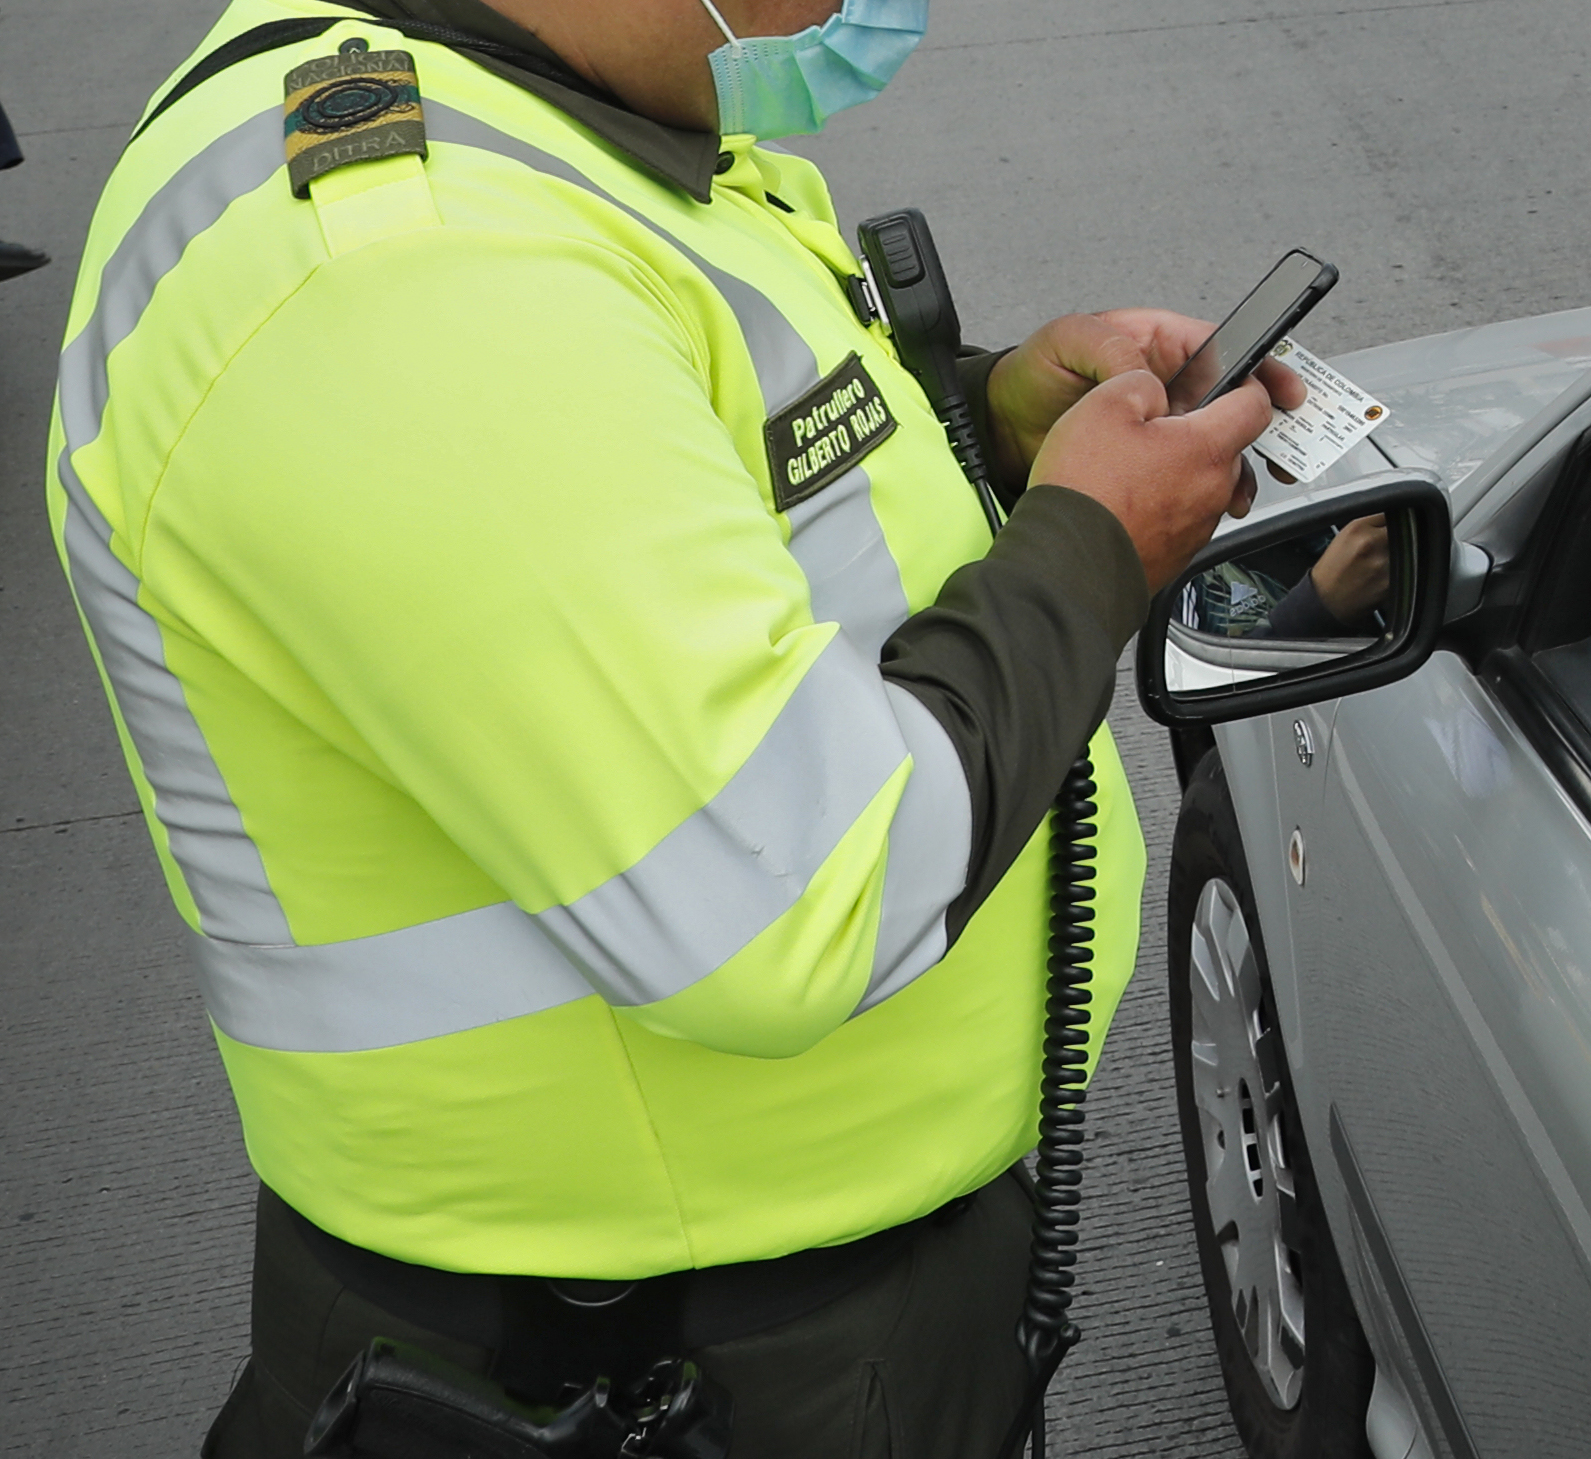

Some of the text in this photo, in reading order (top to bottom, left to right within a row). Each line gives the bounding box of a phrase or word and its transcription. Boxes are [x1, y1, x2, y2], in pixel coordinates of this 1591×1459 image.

[312, 131, 406, 171] DITRA
[1295, 351, 1365, 403] REPÚBLICA DE COLOMBIA
[787, 396, 887, 486] GILBERTO ROJAS
[791, 378, 865, 448] Patrullero
